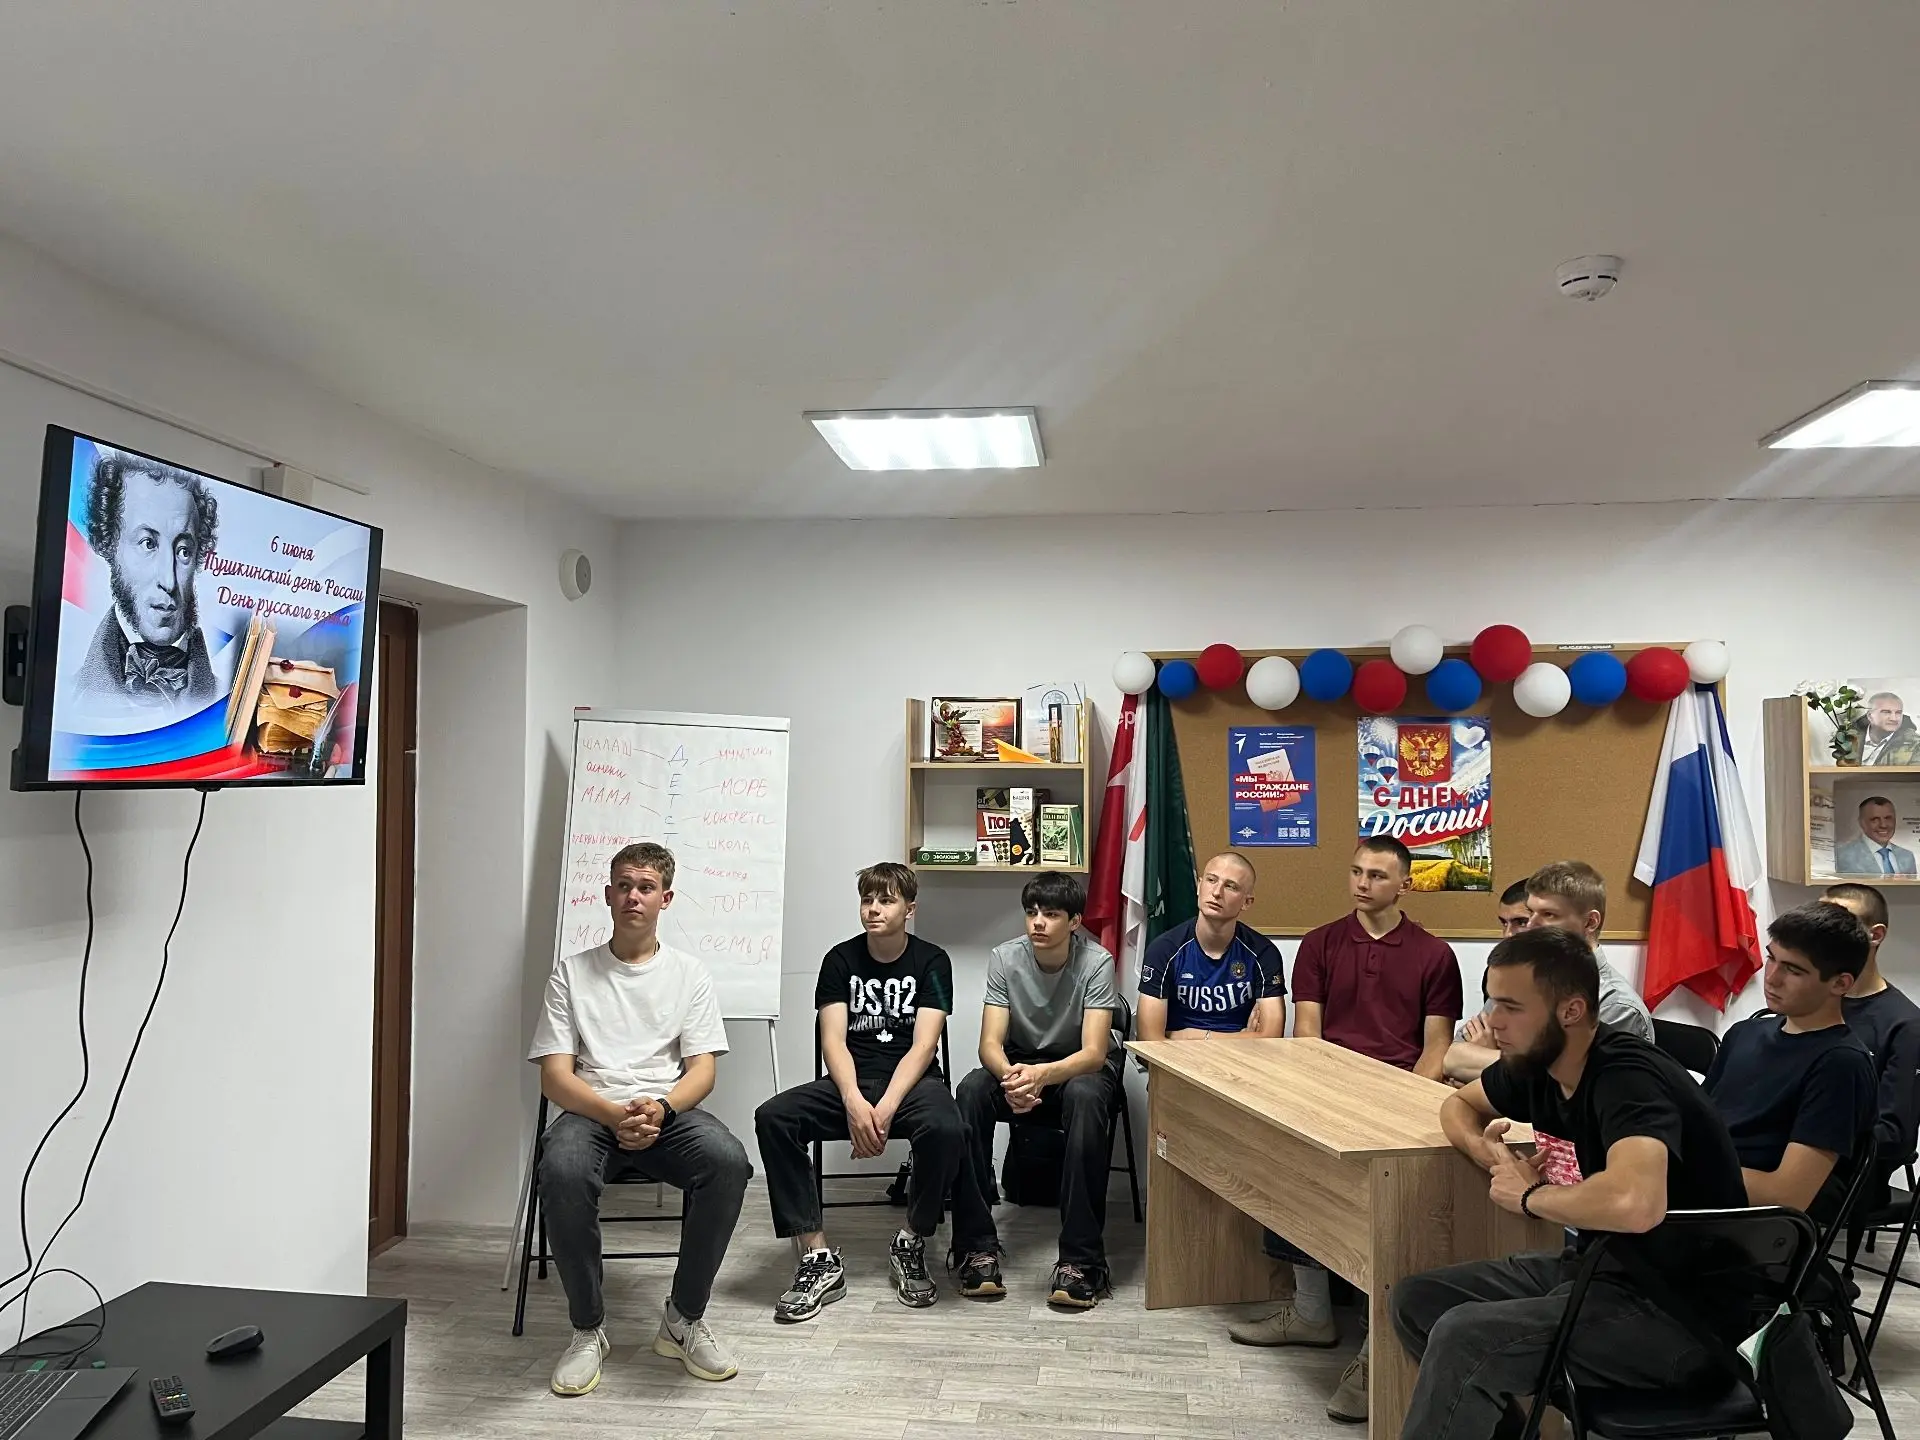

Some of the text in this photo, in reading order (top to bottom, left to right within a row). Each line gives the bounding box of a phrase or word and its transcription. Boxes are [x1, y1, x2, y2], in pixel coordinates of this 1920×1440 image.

[271, 535, 315, 561] 6 июня
[204, 550, 364, 602] Пушкинский день России
[217, 586, 256, 609] День
[255, 597, 313, 618] русского
[581, 785, 631, 806] МАМА
[721, 778, 768, 798] МОРЕ
[1254, 783, 1310, 792] ГРАЖДАНЕ
[1373, 786, 1392, 807] С
[1361, 800, 1489, 839] России!
[708, 839, 751, 853] ШКОЛА
[572, 870, 610, 885] МОРО
[709, 890, 775, 917] ТОРТ
[849, 974, 917, 1018] DSQ2
[1177, 981, 1253, 1012] RUSSIA
